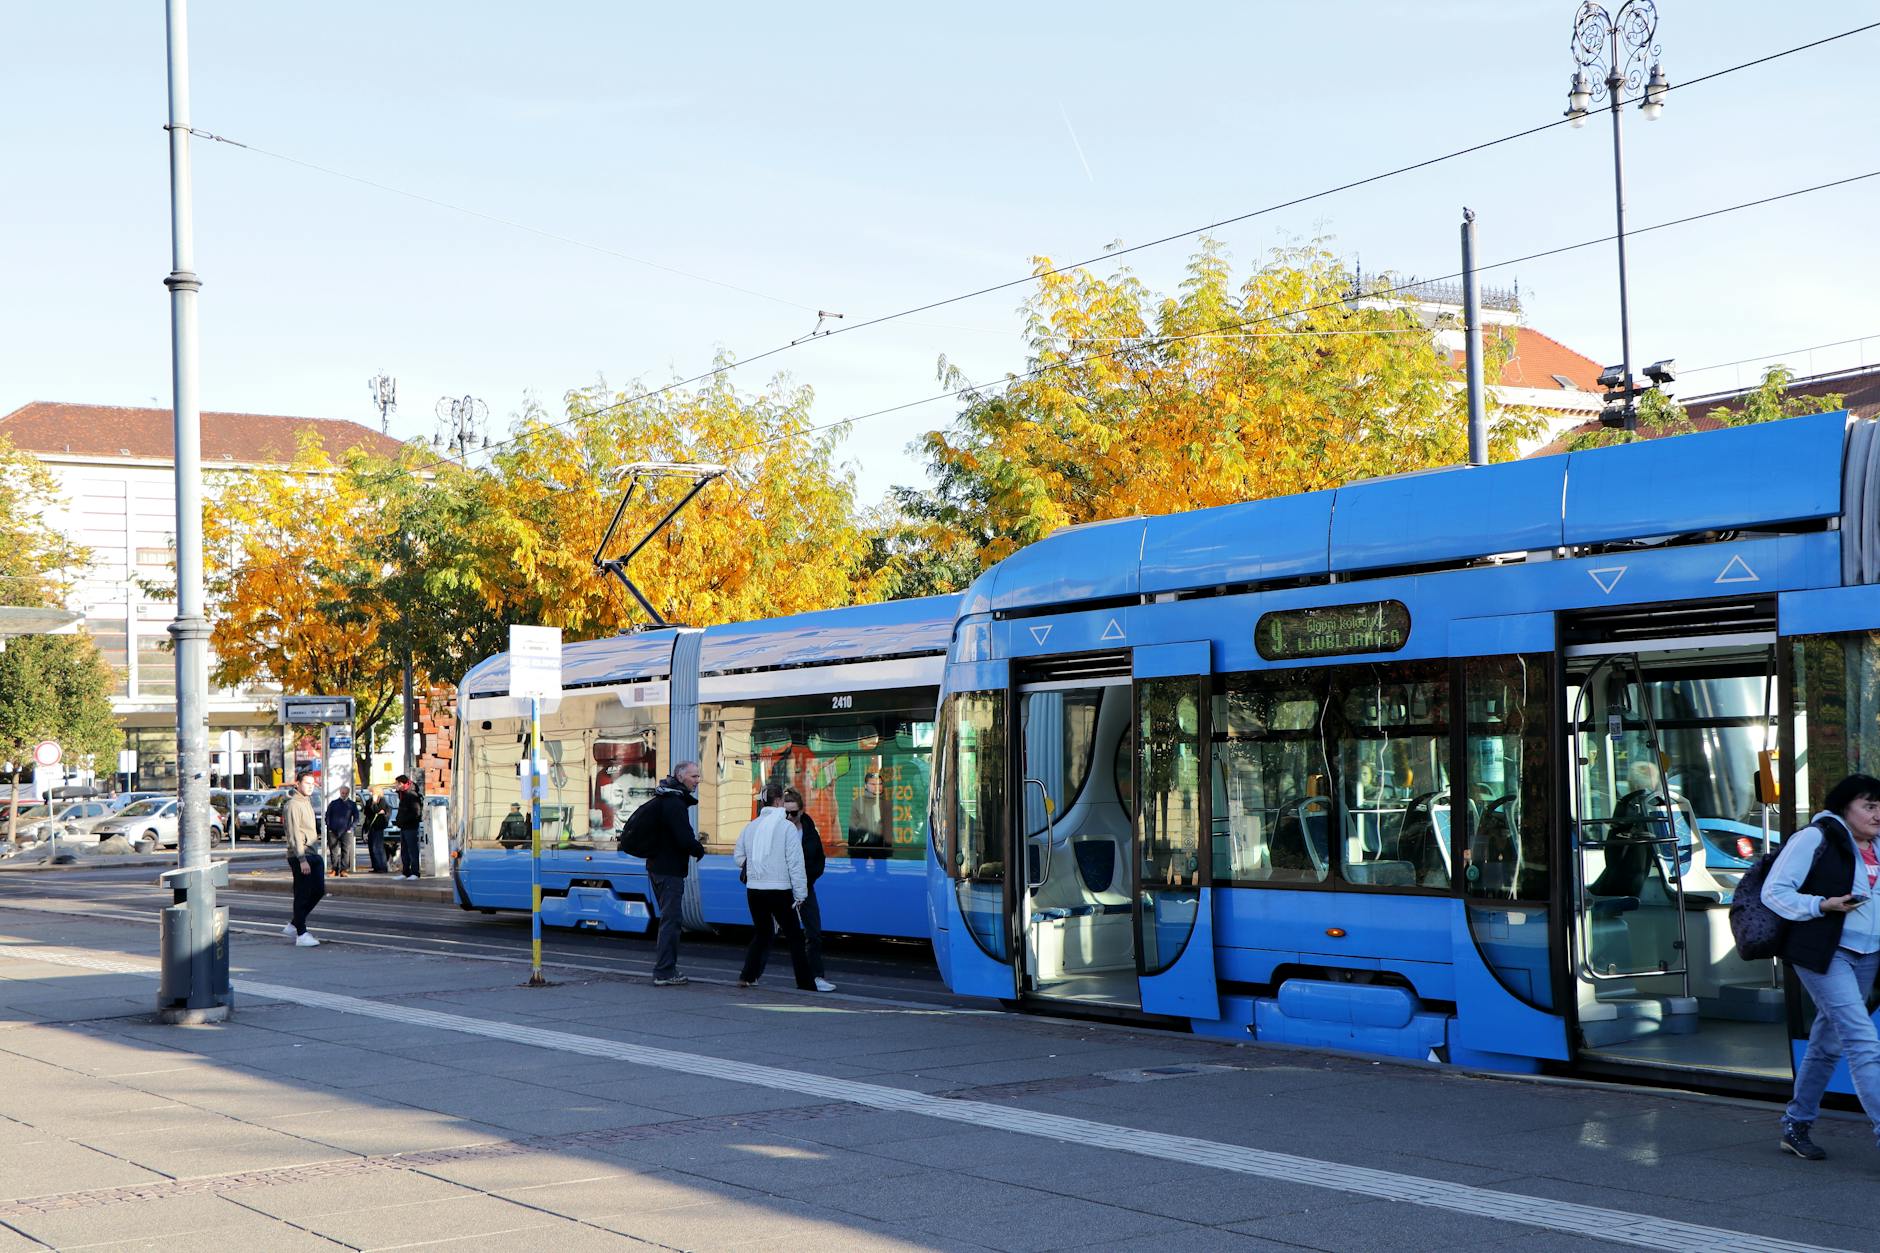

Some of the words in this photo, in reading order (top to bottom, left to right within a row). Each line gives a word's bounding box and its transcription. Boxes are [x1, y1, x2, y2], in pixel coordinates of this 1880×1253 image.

[1307, 615, 1337, 634] Glavni
[1271, 619, 1284, 653] 9
[831, 695, 853, 709] 2410
